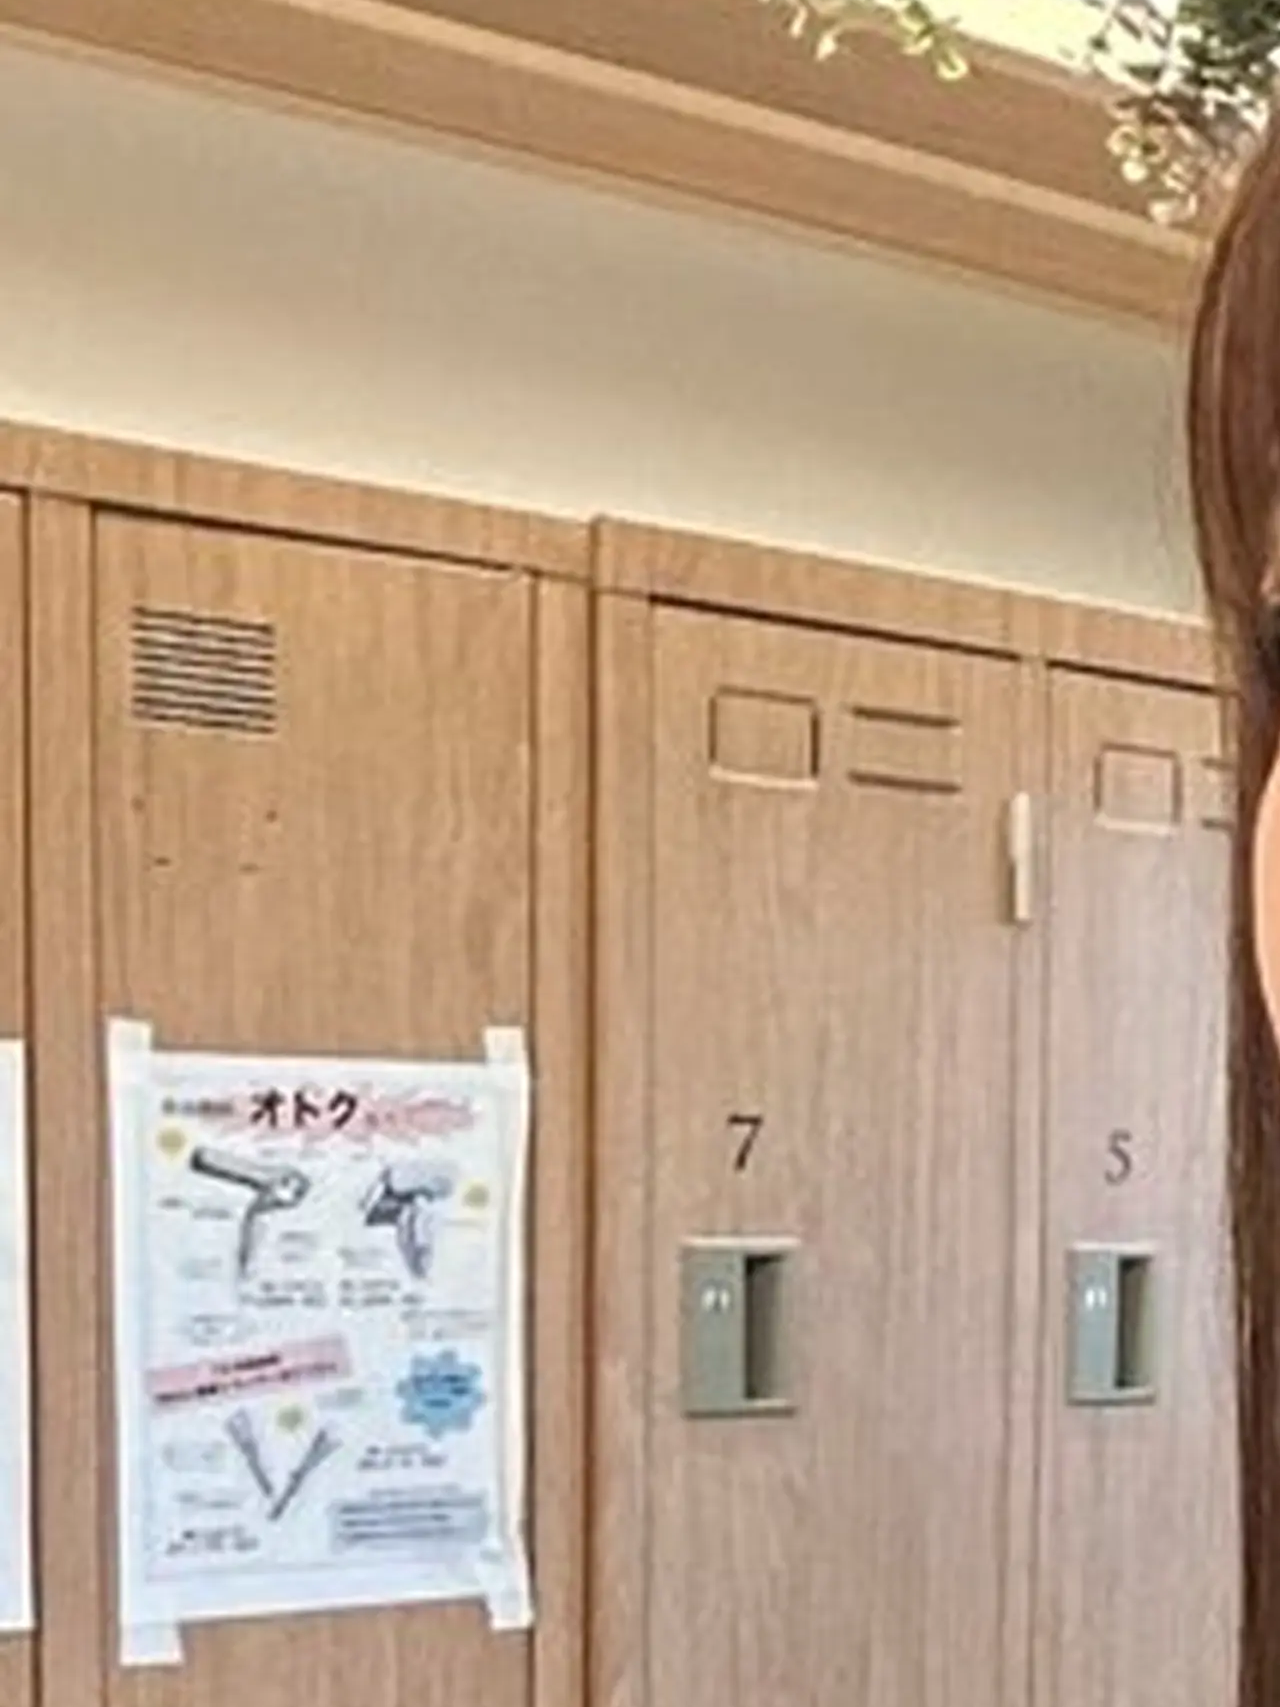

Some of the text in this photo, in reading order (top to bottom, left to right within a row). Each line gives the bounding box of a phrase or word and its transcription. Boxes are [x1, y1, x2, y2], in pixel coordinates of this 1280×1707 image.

[249, 1089, 358, 1130] オトク
[726, 1115, 764, 1171] 7
[1105, 1130, 1134, 1186] 5
